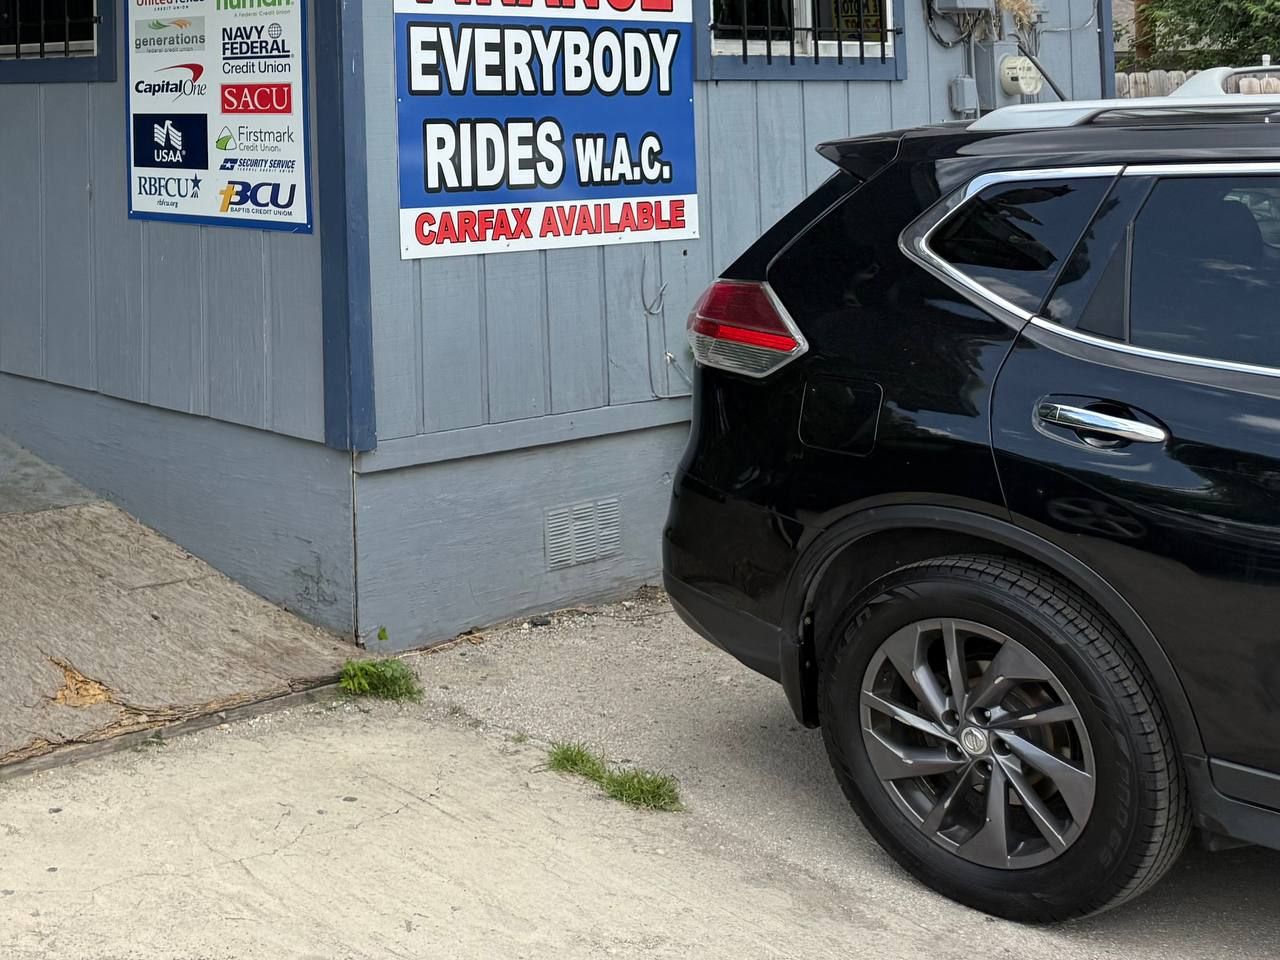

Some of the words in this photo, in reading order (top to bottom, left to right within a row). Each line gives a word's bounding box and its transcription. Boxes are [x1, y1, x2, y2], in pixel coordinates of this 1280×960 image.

[135, 33, 206, 49] generations
[221, 25, 265, 41] NAVY
[222, 39, 290, 56] FEDERAL
[407, 21, 681, 96] EVERYBODY
[222, 61, 256, 74] Credit
[258, 61, 291, 74] Union
[224, 87, 289, 111] SACU
[238, 125, 295, 143] Firstmark
[238, 142, 258, 152] Credit
[422, 116, 565, 194] RIDES
[573, 132, 673, 187] W.A.C.
[154, 149, 182, 163] USAA
[237, 158, 268, 168] SECURITY
[268, 159, 296, 169] SERVICE
[137, 176, 189, 198] RBFCU
[227, 180, 297, 209] BCU
[414, 206, 533, 247] CARFAX
[539, 199, 686, 238] AVAILABLE
